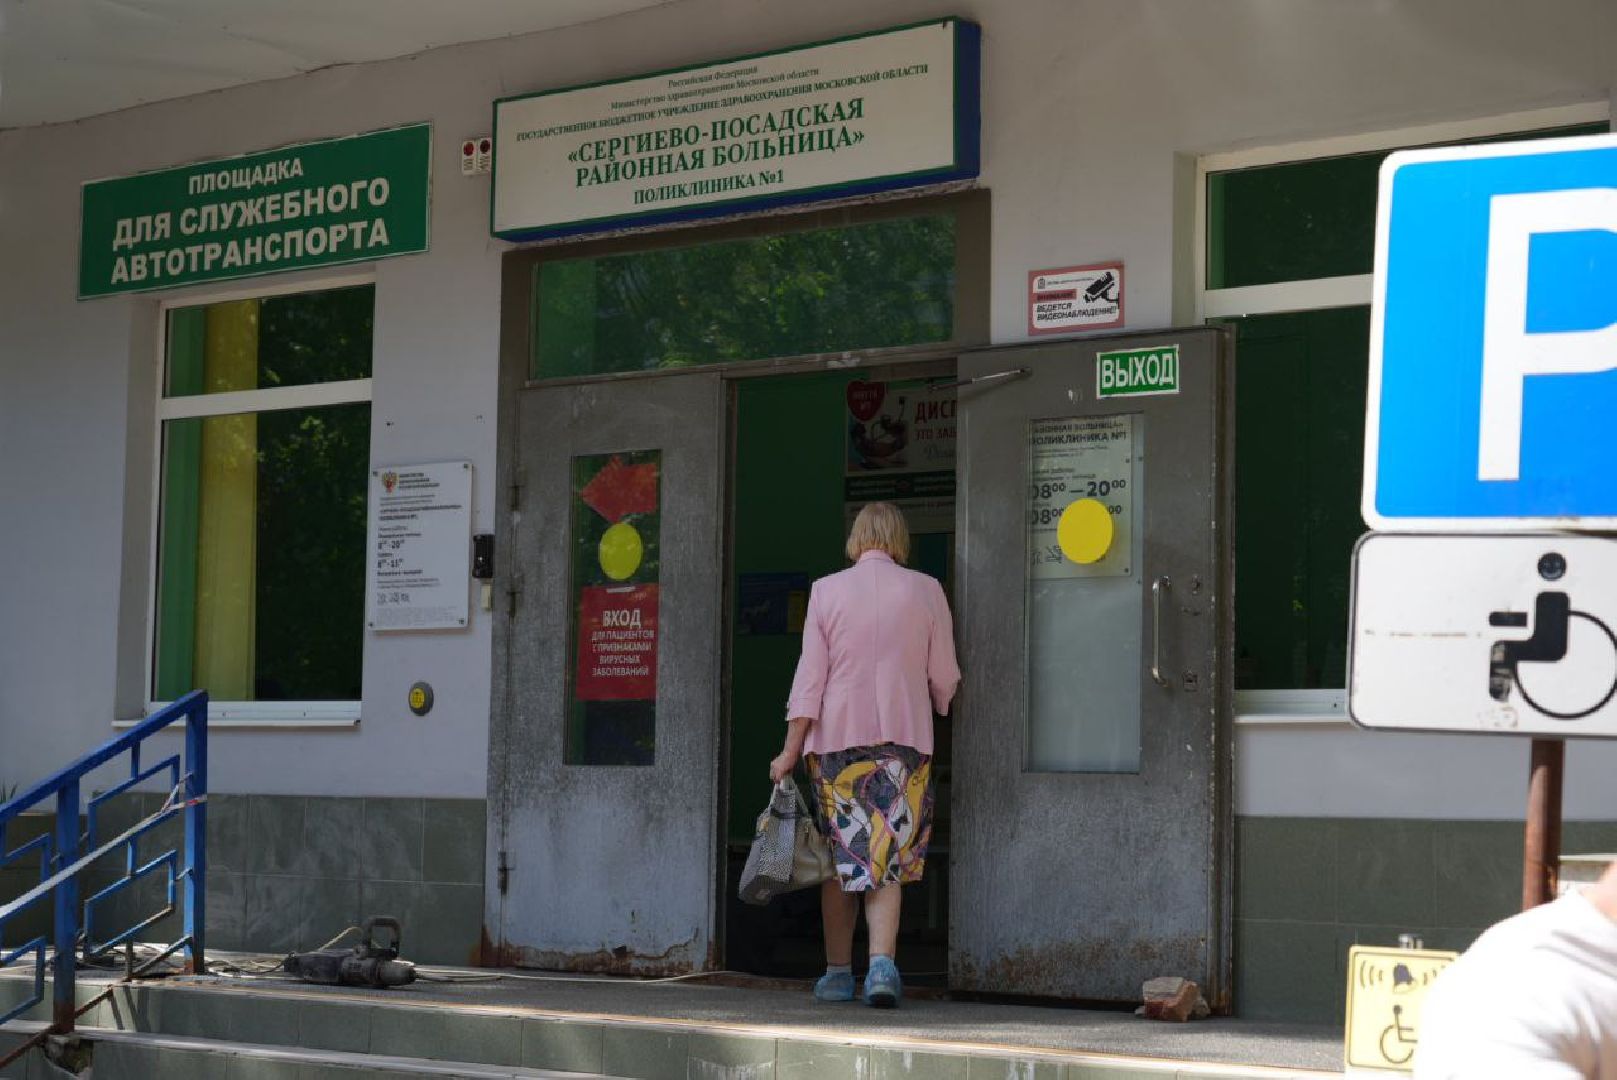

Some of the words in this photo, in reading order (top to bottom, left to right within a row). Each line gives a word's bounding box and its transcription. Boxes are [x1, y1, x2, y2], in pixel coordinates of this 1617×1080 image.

[516, 121, 597, 142] ГОСУДАРСТВЕННОЕ
[599, 111, 656, 128] БЮДЖЕТНОЕ
[657, 101, 721, 118] УЧРЕЖДЕНИЕ
[721, 83, 812, 107] ЗДРАВООХРАНЕНИЯ
[814, 71, 880, 91] МОСКОВСКОЙ
[882, 64, 928, 81] ОБЛАСТИ
[568, 98, 864, 163] «СЕРГИЕВО-ПОСАДСКАЯ
[189, 157, 304, 195] ПЛОЩАДКА
[576, 149, 704, 187] РАЙОННАЯ
[712, 125, 865, 167] БОЛЬНИЦА»
[634, 174, 755, 205] ПОЛИКЛИНИКА
[759, 169, 784, 186] №1
[112, 212, 172, 252] ДЛЯ
[180, 177, 389, 236] СЛУЖЕБНОГО
[110, 217, 390, 285] АВТОТРАНСПОРТА
[1477, 187, 1617, 481] P
[1102, 353, 1174, 389] ВЫХОД
[603, 610, 641, 629] ВХОД
[592, 666, 649, 677] ЗАБОЛЕВАНИЙ
[600, 654, 641, 665] ВИРУСНЫХ
